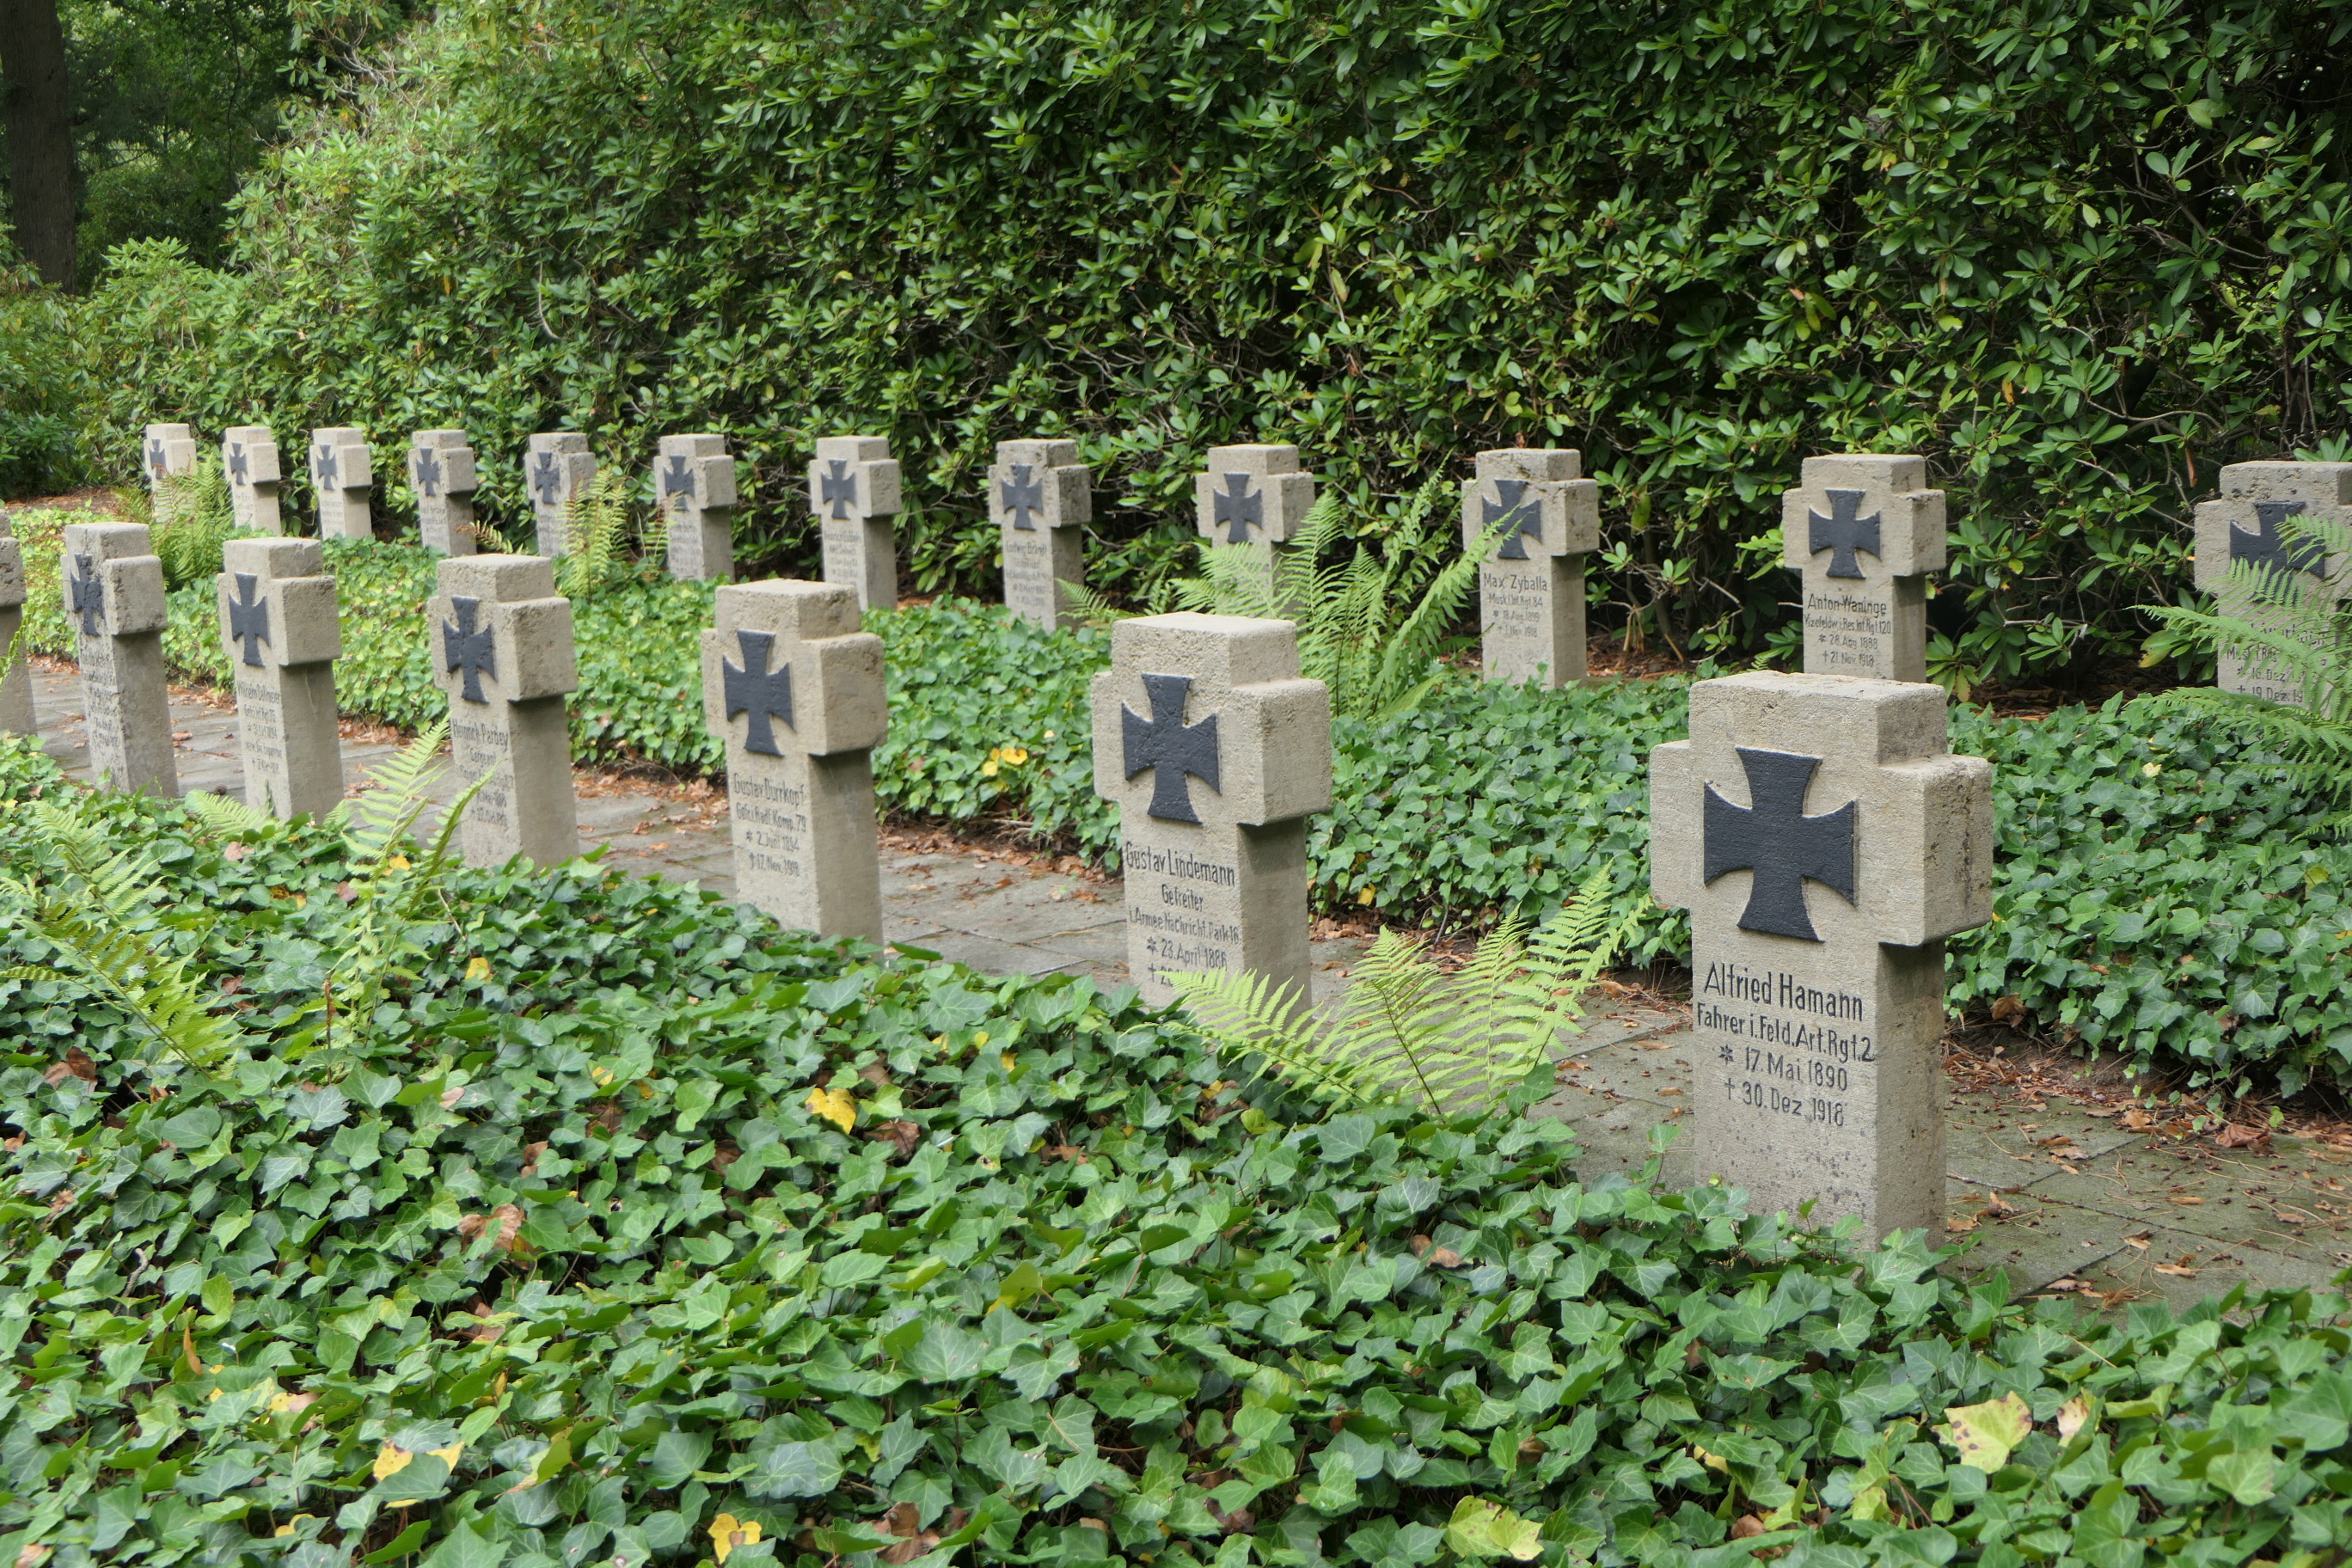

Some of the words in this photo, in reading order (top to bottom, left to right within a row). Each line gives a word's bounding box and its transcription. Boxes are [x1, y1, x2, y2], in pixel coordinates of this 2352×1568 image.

[1484, 573, 1506, 589] Max
[1510, 574, 1547, 593] Zyballa
[1807, 593, 1840, 611] Anton
[470, 748, 496, 768] Sergeant
[734, 773, 764, 798] Gustav
[1126, 841, 1166, 873] Gustav
[1167, 848, 1235, 887] Lindemann
[1161, 884, 1204, 912] Gefreiter
[1704, 961, 1772, 1004] Alfried
[1779, 972, 1863, 1021] Hamann
[1697, 1002, 1745, 1034] Fahrer
[1767, 1051, 1801, 1081] Mai
[1808, 1060, 1847, 1091] 1890
[1812, 1098, 1844, 1126] 1918
